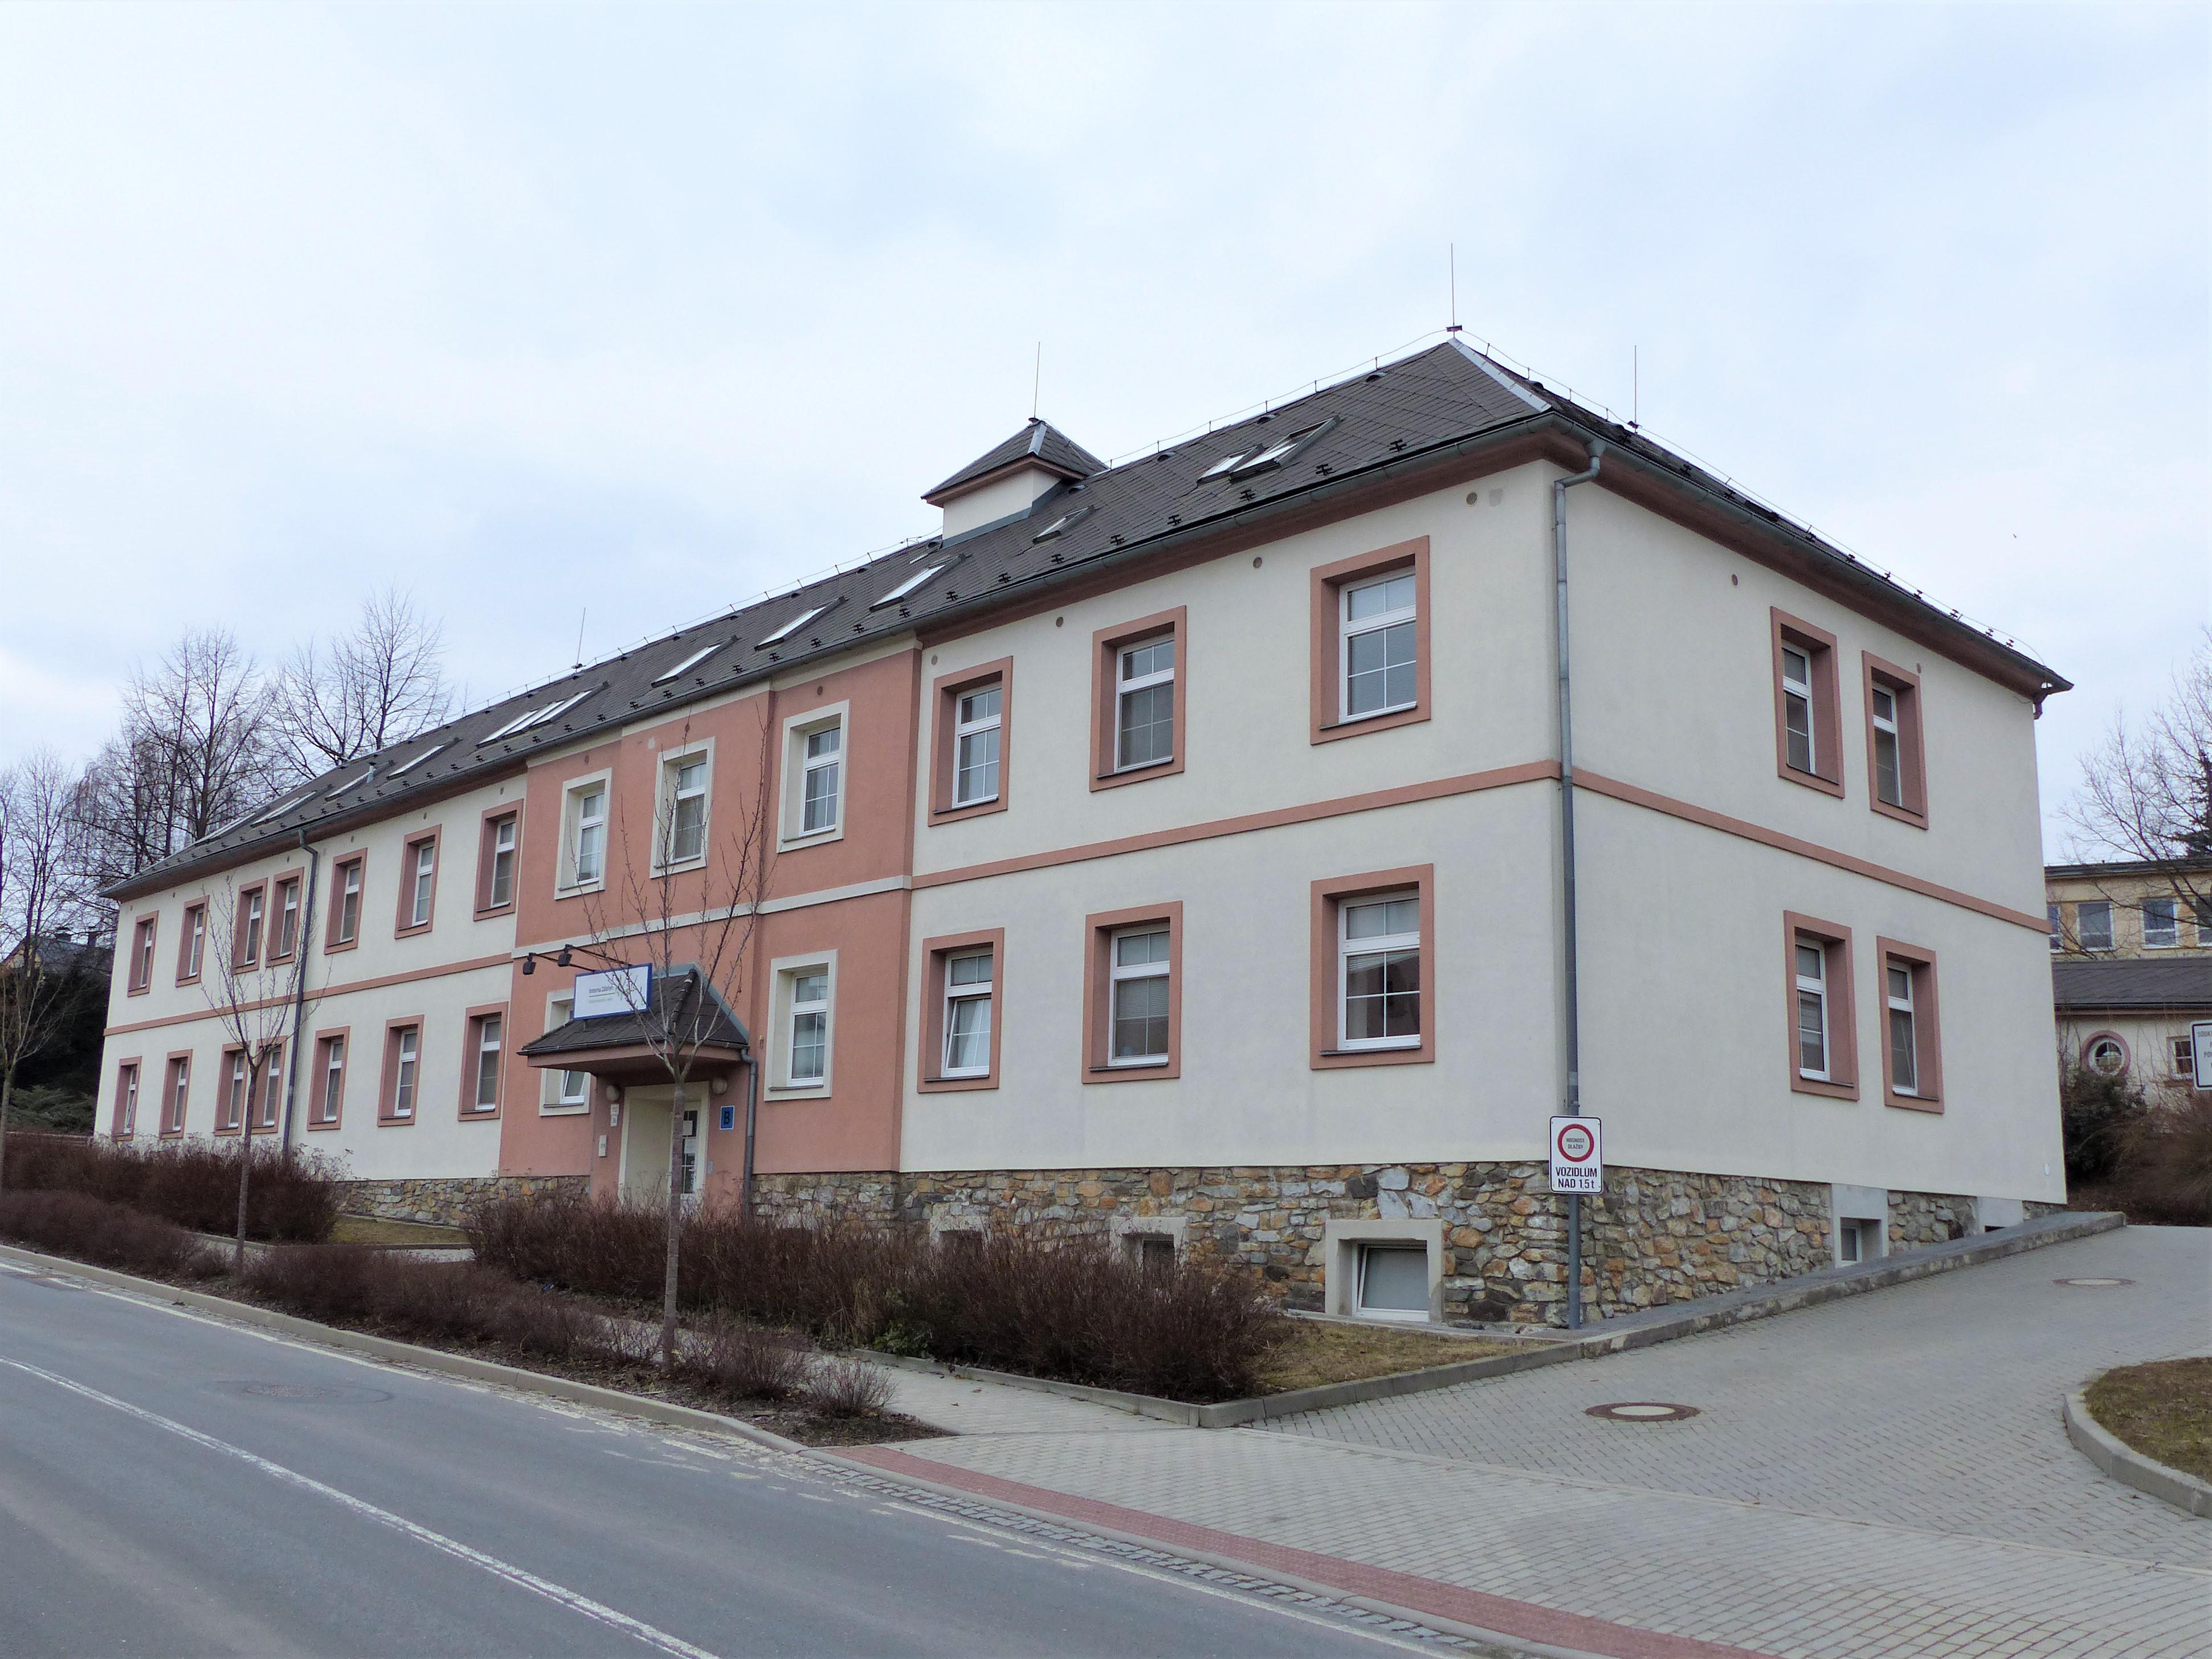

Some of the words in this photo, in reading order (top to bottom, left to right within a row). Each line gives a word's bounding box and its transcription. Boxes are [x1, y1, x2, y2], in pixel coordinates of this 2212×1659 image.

[1556, 1167, 1597, 1177] VOZIDLŮM
[1558, 1179, 1576, 1188] NAD
[1579, 1179, 1589, 1189] 1,5
[1591, 1180, 1595, 1189] t
